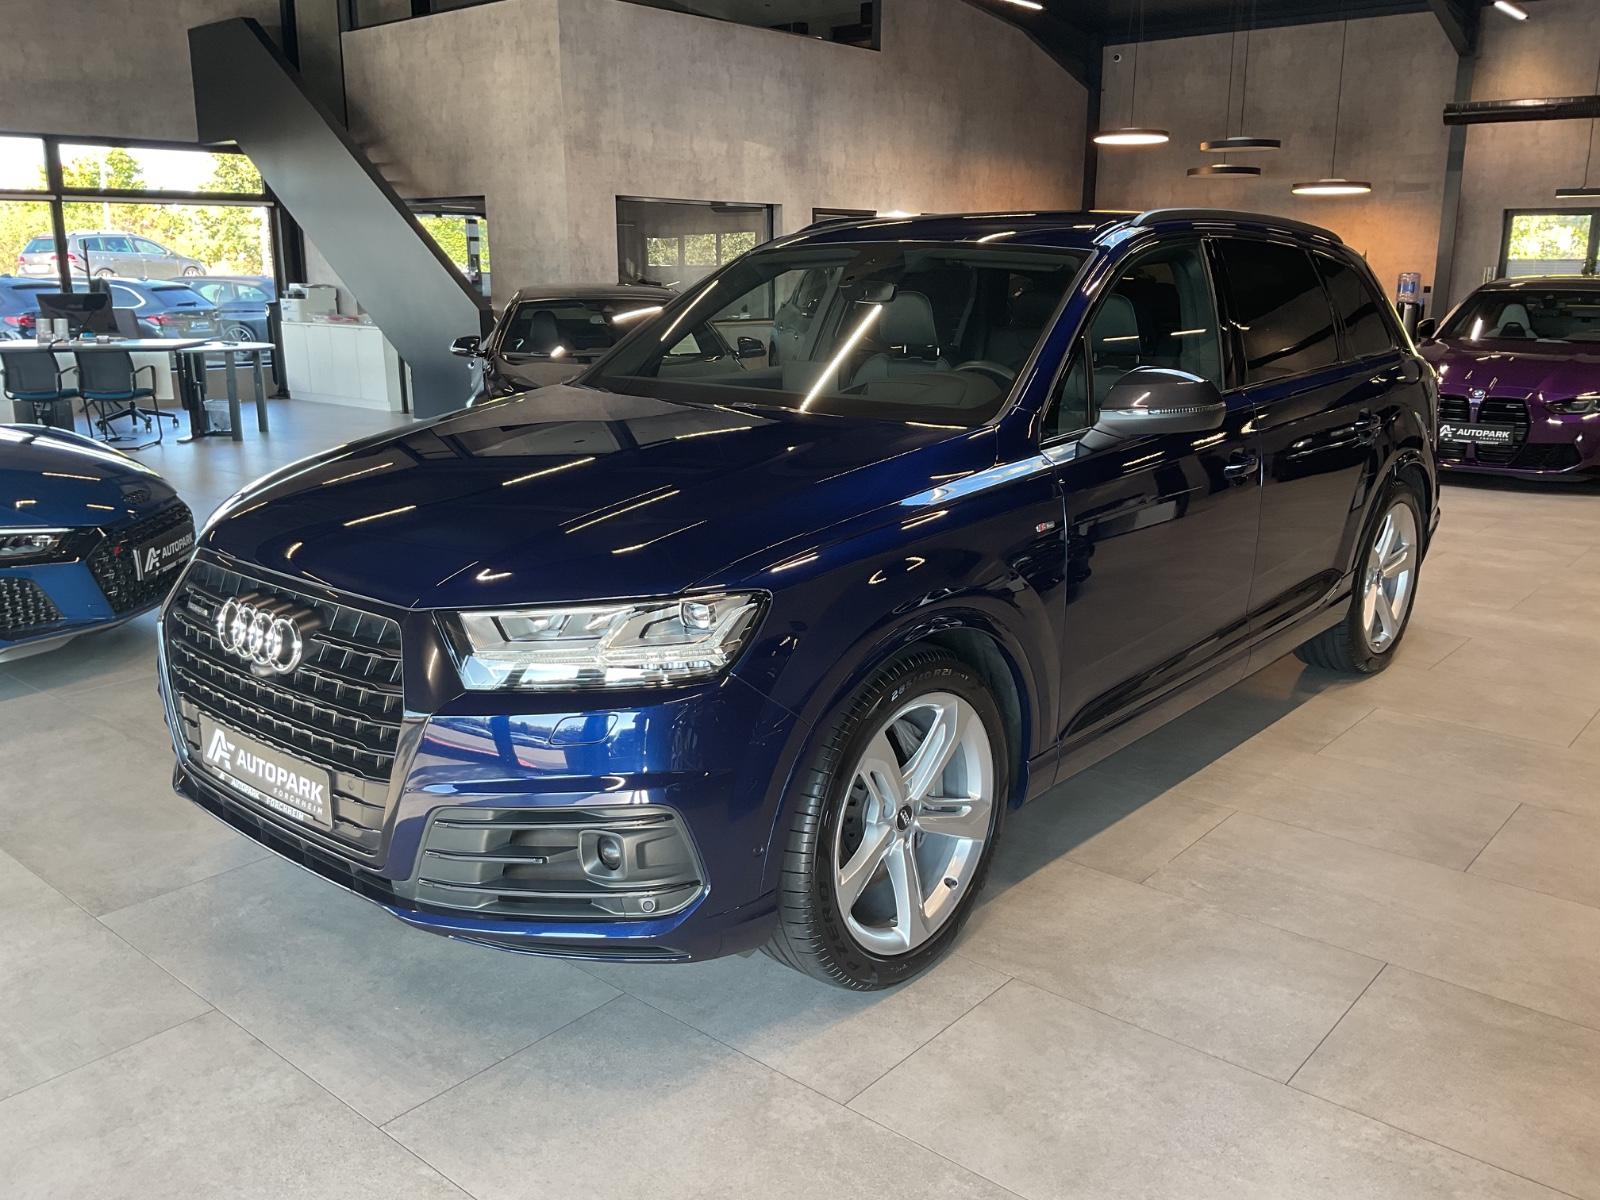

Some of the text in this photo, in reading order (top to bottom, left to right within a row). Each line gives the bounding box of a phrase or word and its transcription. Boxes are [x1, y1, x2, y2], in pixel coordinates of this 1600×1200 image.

[1456, 429, 1510, 438] AUTOPARK
[162, 532, 193, 559] AUTOPARK
[231, 779, 261, 800] AUTOPARK
[236, 749, 324, 804] AUTOPARK
[273, 787, 323, 816] FORCHHEIM
